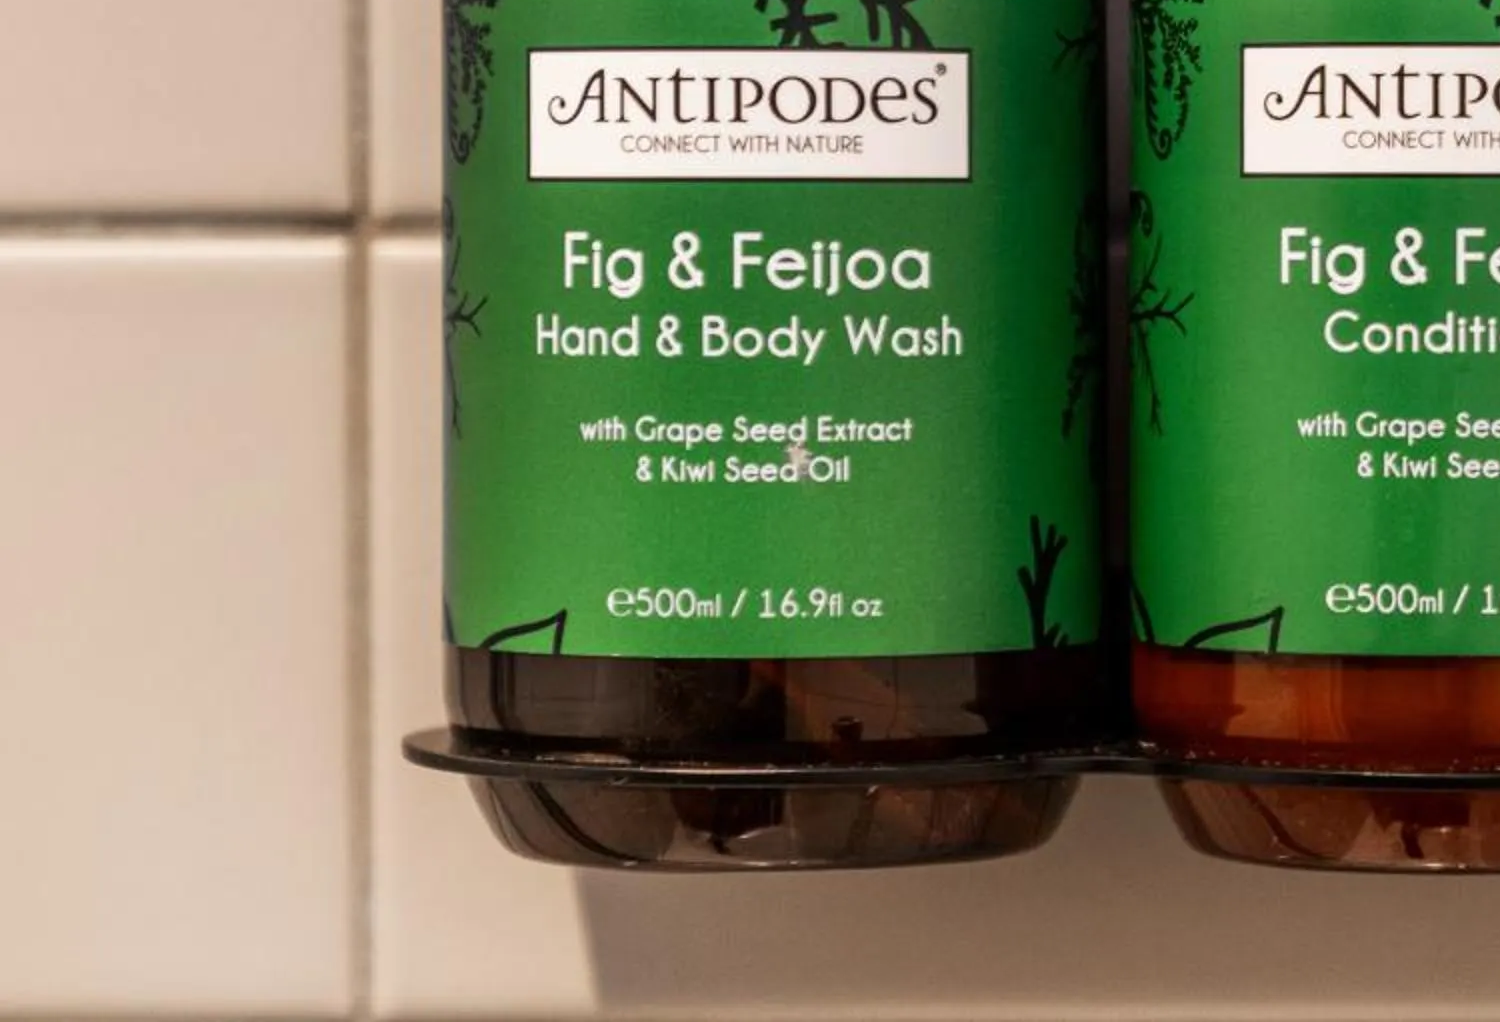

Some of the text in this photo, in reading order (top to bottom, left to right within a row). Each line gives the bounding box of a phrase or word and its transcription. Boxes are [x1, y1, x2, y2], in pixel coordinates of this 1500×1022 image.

[620, 134, 864, 155] CONNECT WITH NATURE
[1342, 129, 1446, 150] CONNECT
[564, 230, 931, 299] Fig & Feijoa
[1280, 226, 1366, 295] Fig
[1389, 226, 1428, 286] &
[536, 313, 962, 366] Hand & Body Wash
[579, 414, 913, 451] with Grape Seed Extract
[1297, 411, 1347, 437] with
[1355, 410, 1447, 446] Grape
[635, 455, 850, 483] & Kiwi Seed Oil
[1357, 451, 1374, 478] &
[1383, 451, 1437, 479] Kiwi
[730, 588, 748, 618] /
[759, 586, 844, 619] 16.9fl
[851, 597, 884, 618] oz
[1452, 583, 1470, 615] /
